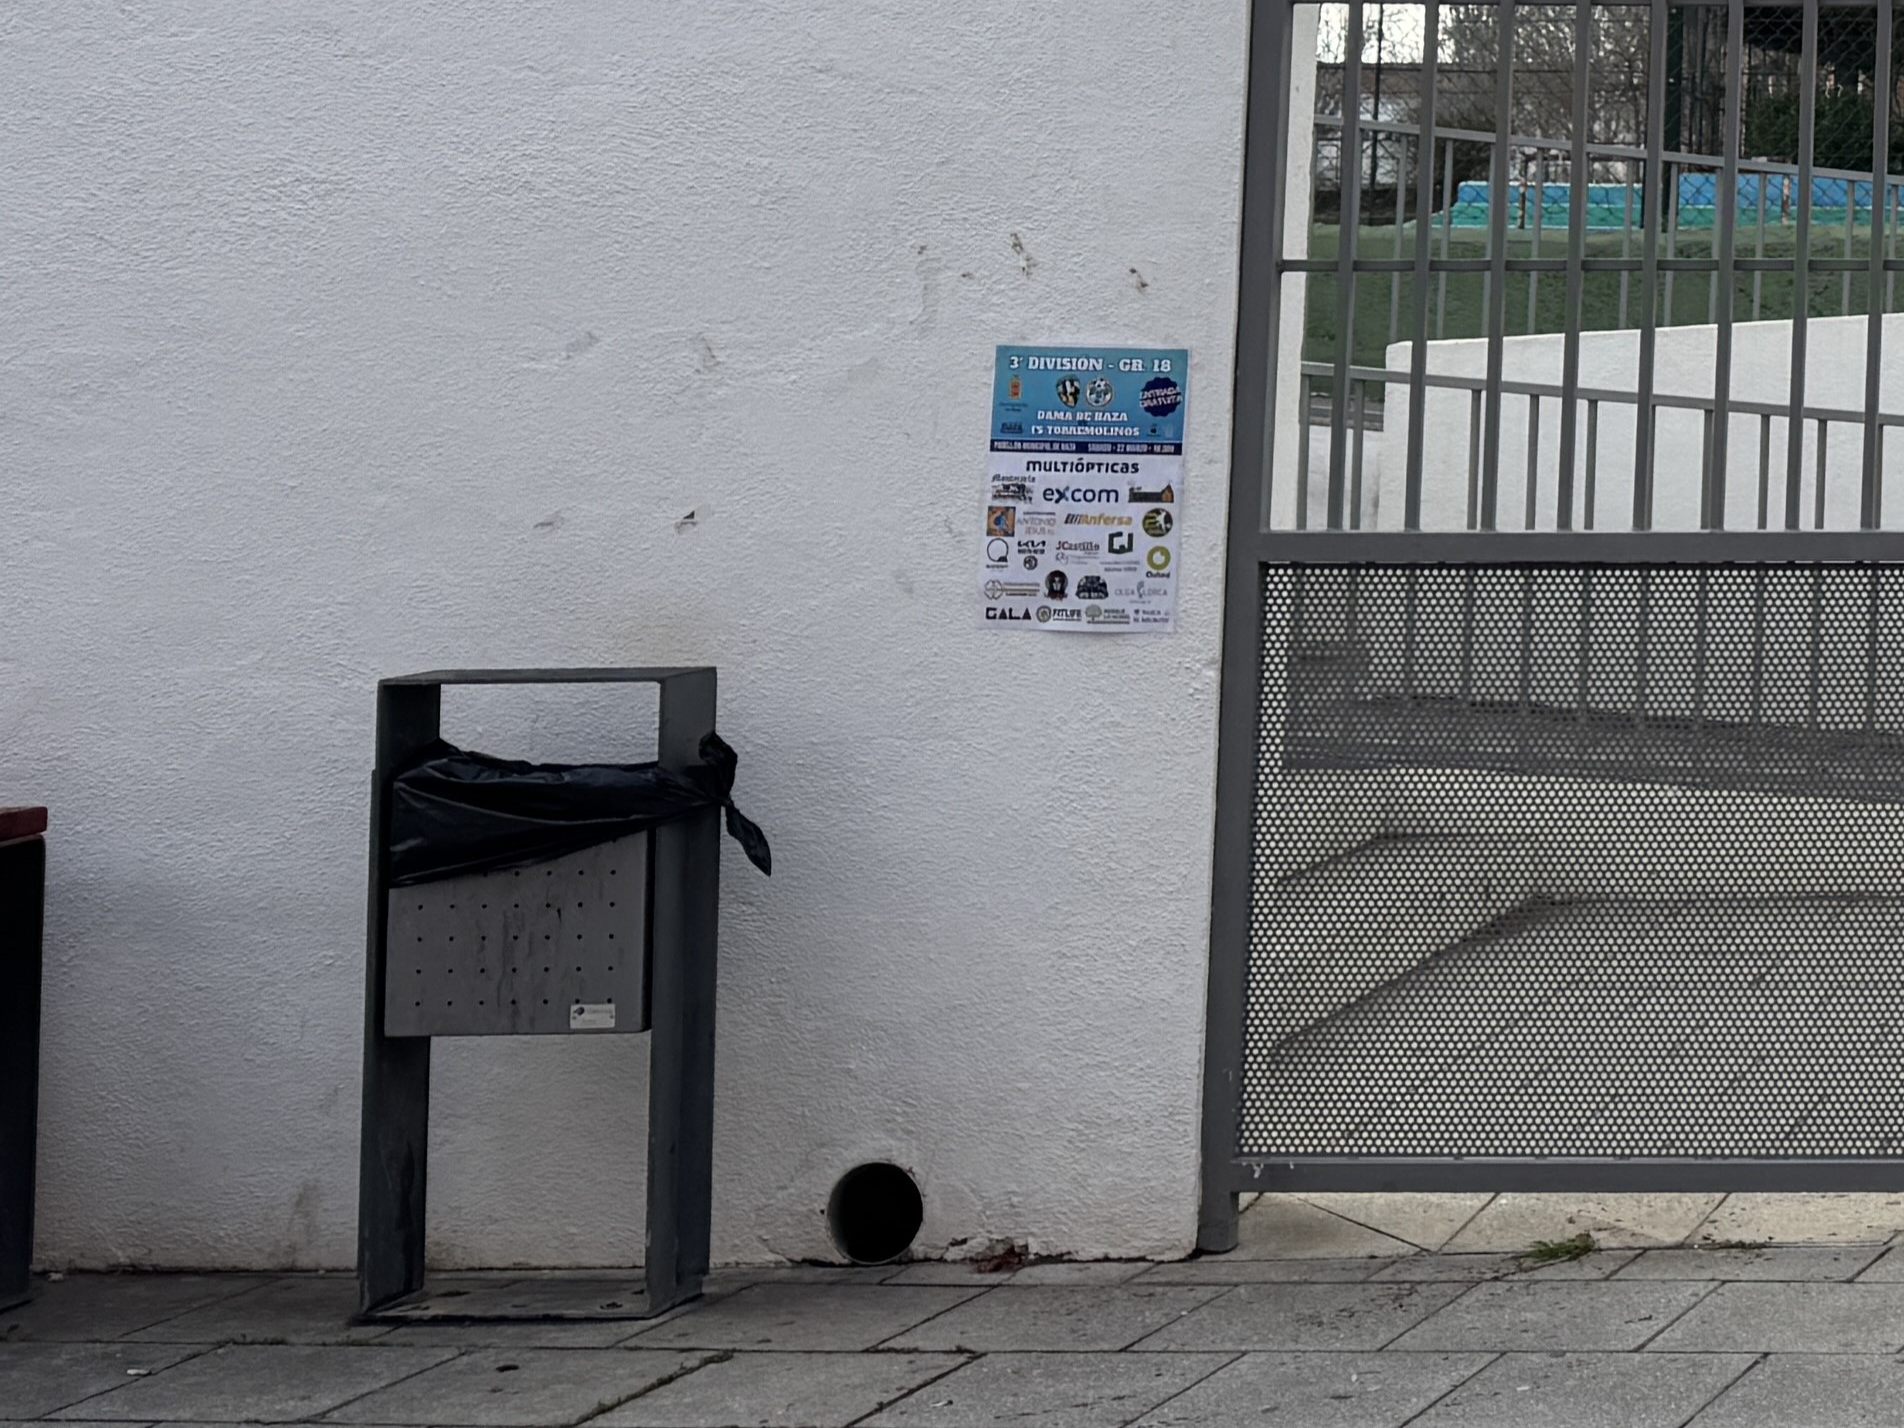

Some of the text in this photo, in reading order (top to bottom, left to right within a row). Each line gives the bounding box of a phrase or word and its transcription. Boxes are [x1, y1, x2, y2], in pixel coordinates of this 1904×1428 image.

[1153, 359, 1171, 372] 18
[1037, 410, 1073, 421] DAMA
[1047, 425, 1140, 437] TORREMOLINOS
[1042, 485, 1120, 504] excom
[985, 606, 1032, 621] GALA
